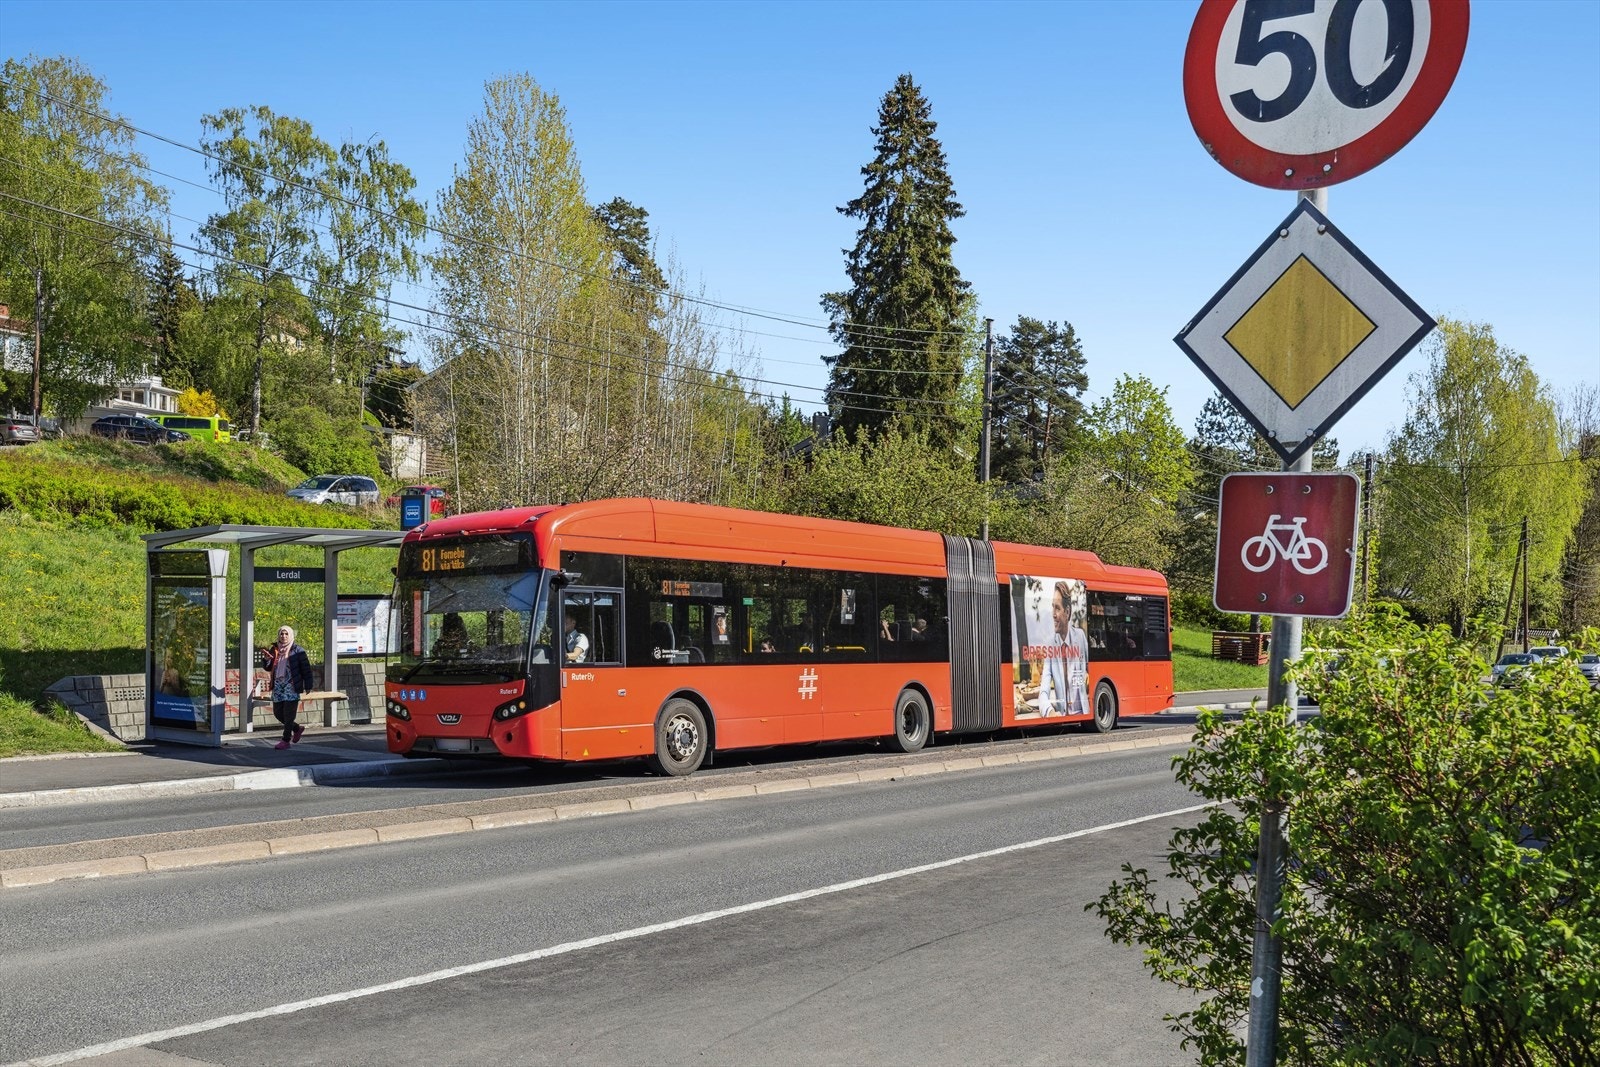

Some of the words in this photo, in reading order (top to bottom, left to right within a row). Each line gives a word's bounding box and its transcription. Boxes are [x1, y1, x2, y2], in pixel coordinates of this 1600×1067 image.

[1229, 0, 1415, 123] 50
[422, 549, 436, 571] 81
[441, 548, 465, 559] Fornebu
[276, 570, 301, 579] Lerdal
[662, 580, 672, 595] 81
[1022, 645, 1080, 660] DRESSMANN
